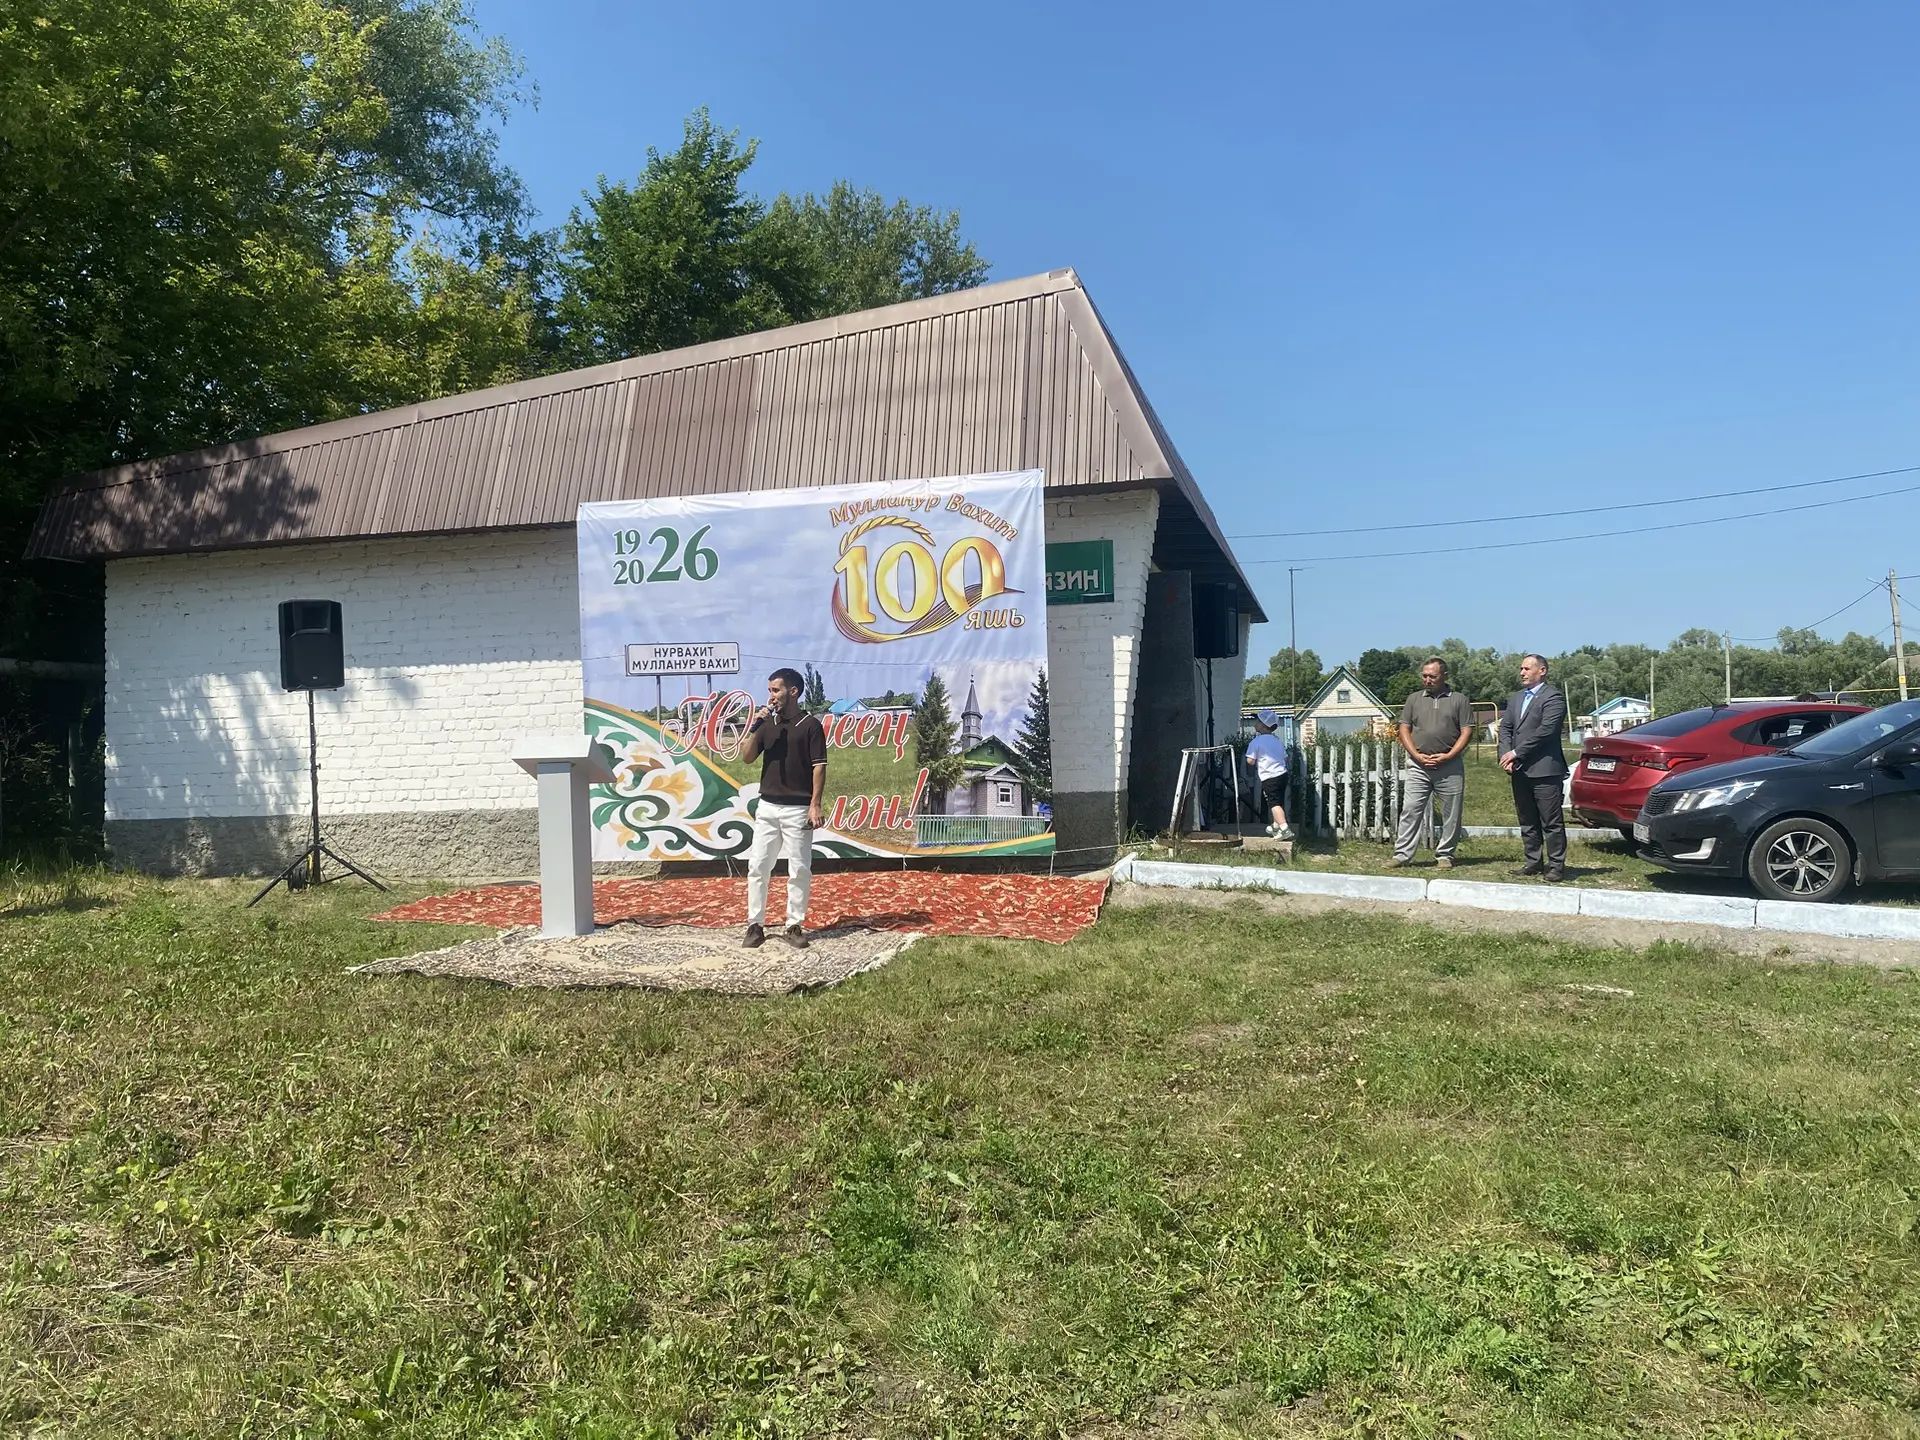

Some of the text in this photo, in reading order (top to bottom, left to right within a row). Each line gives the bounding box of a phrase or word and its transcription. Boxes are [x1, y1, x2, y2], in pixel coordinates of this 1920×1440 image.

[945, 493, 1019, 542] Вахит
[613, 529, 641, 556] 19
[646, 524, 719, 583] 26
[612, 559, 645, 585] 20
[833, 536, 1006, 625] 100
[964, 608, 1026, 630] яшь
[632, 657, 737, 671] МУЛЛАНУР ВАХИТ
[654, 646, 714, 658] НУРВАХИТ
